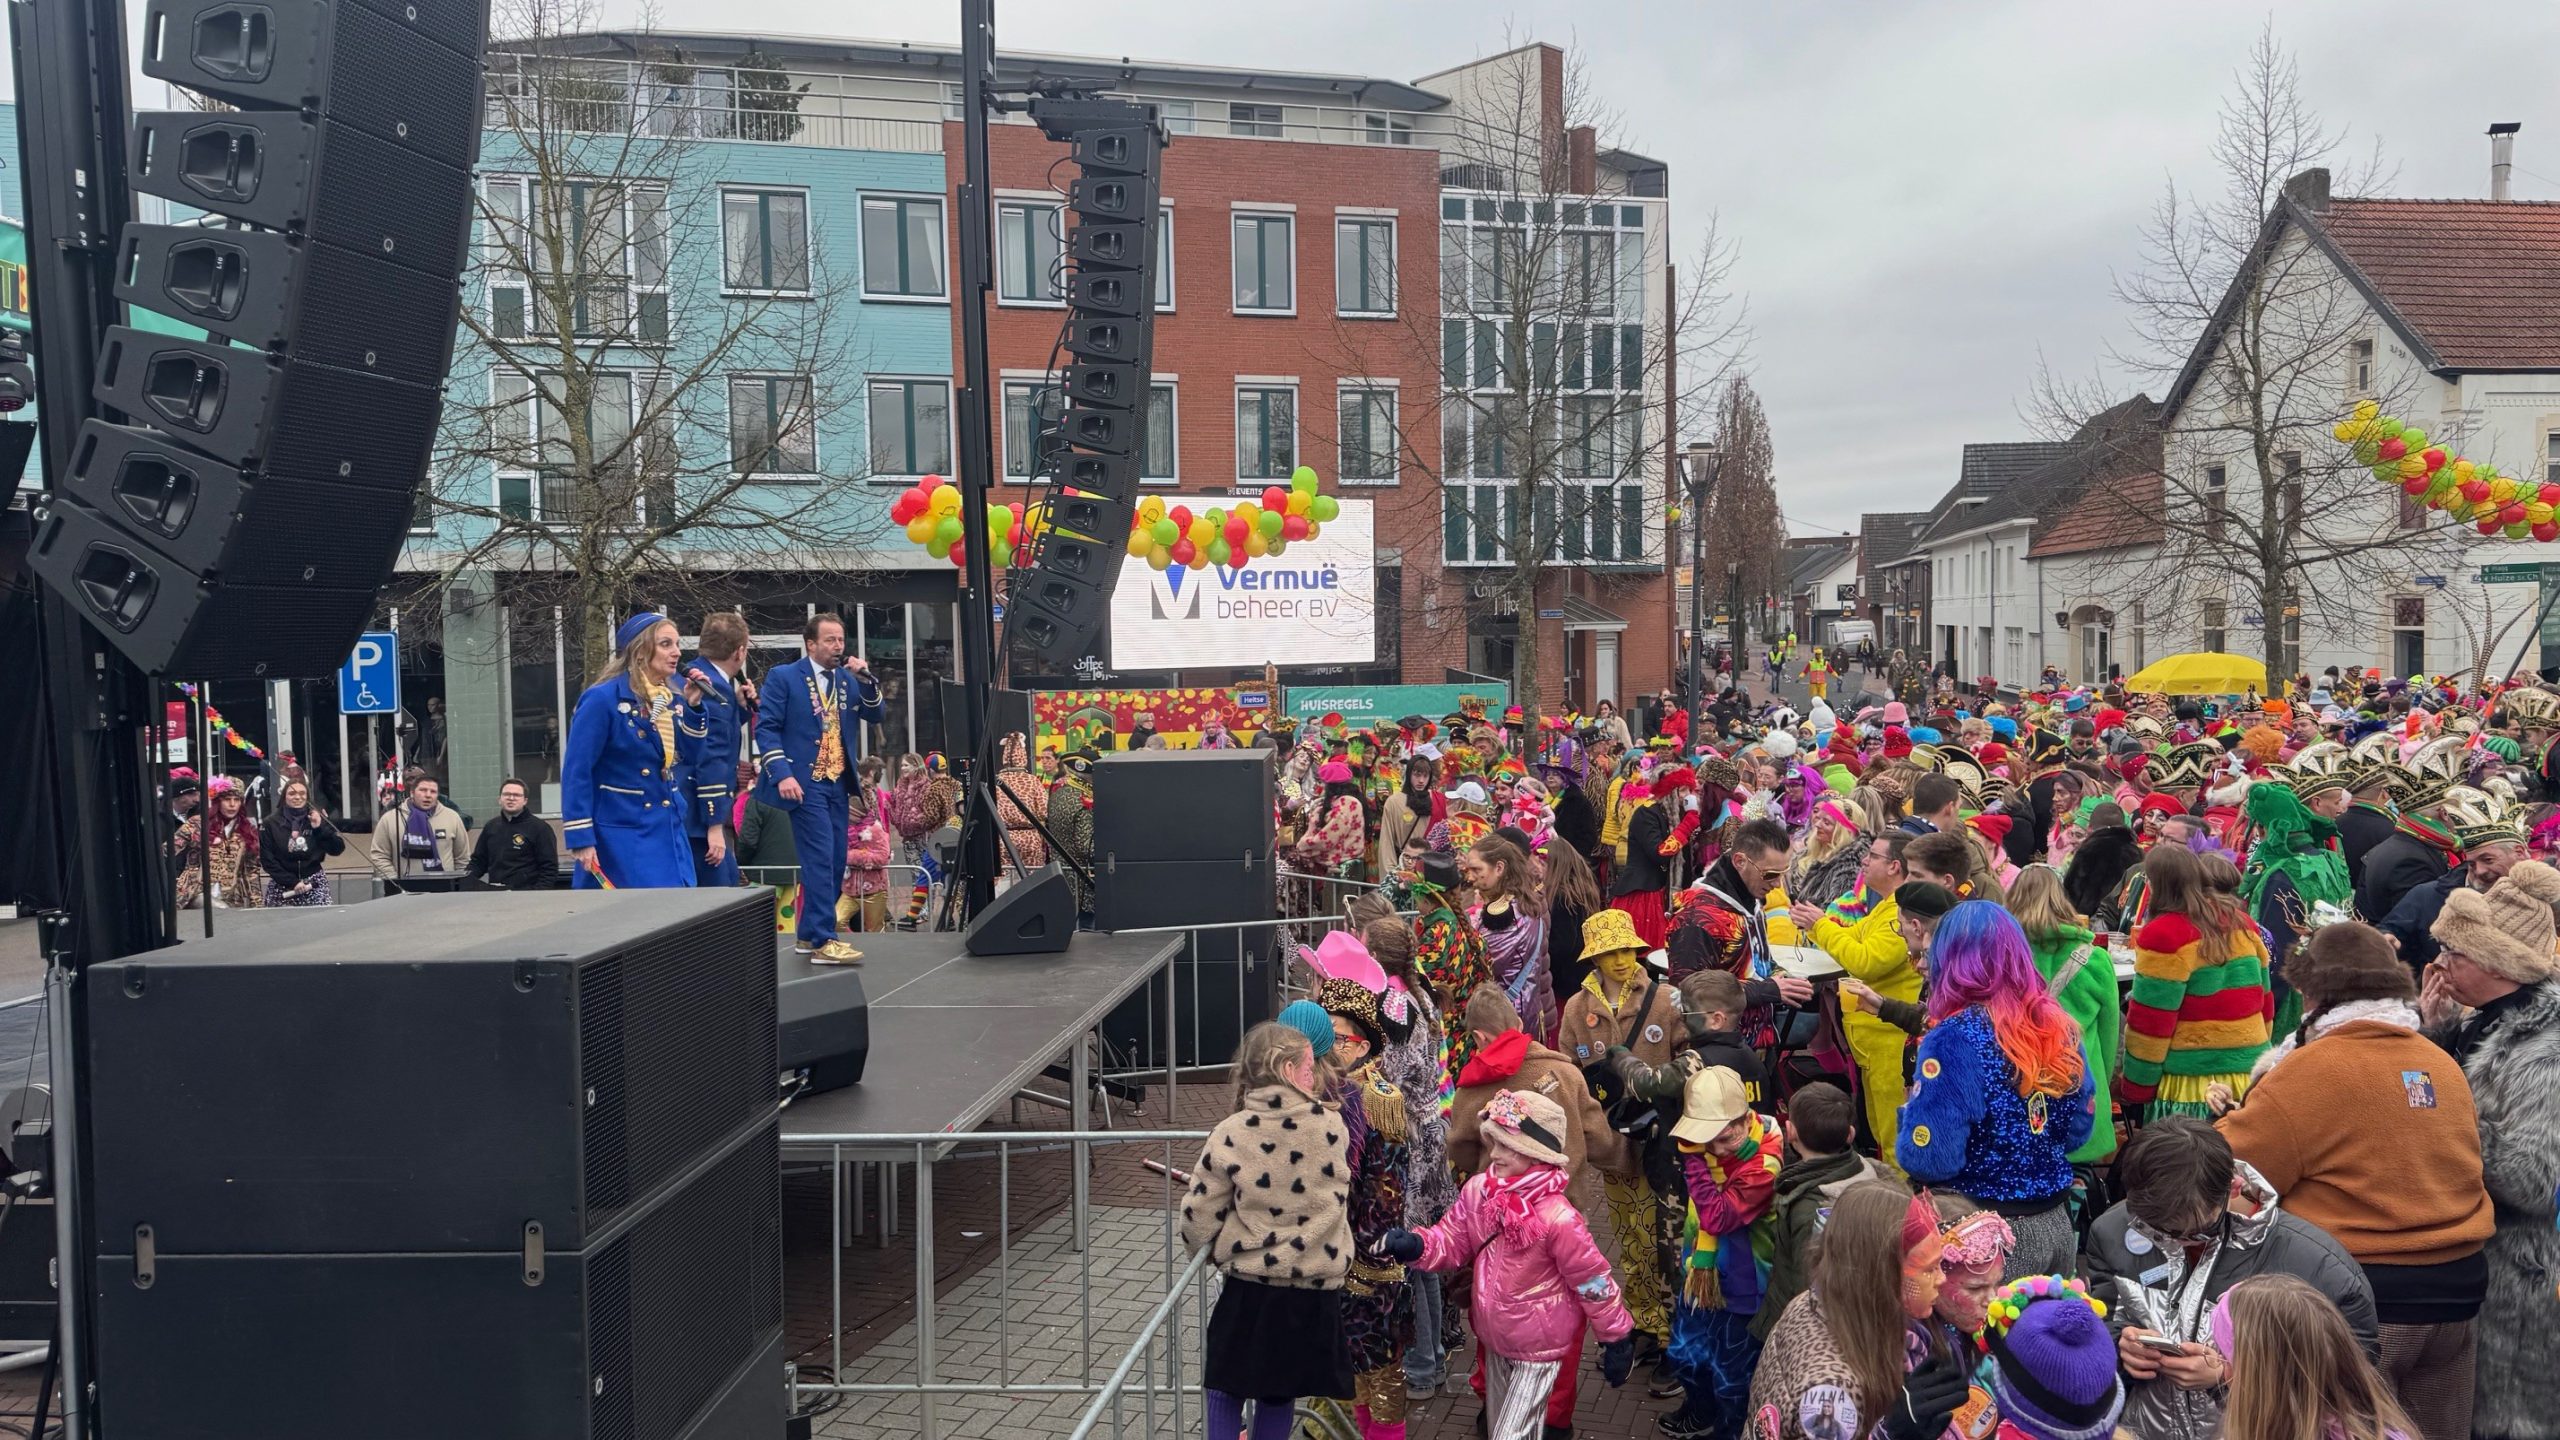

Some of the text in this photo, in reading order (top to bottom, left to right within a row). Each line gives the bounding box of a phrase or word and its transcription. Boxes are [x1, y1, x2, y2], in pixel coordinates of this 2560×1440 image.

[1235, 487, 1264, 496] EVENTS
[1216, 563, 1338, 591] Vermuë
[1218, 595, 1339, 619] beheer BV
[352, 641, 382, 681] P
[1073, 655, 1104, 672] Coffee
[1300, 698, 1374, 711] HUISREGELS
[1745, 1081, 1762, 1102] BI
[1804, 1390, 1845, 1405] IVANA
